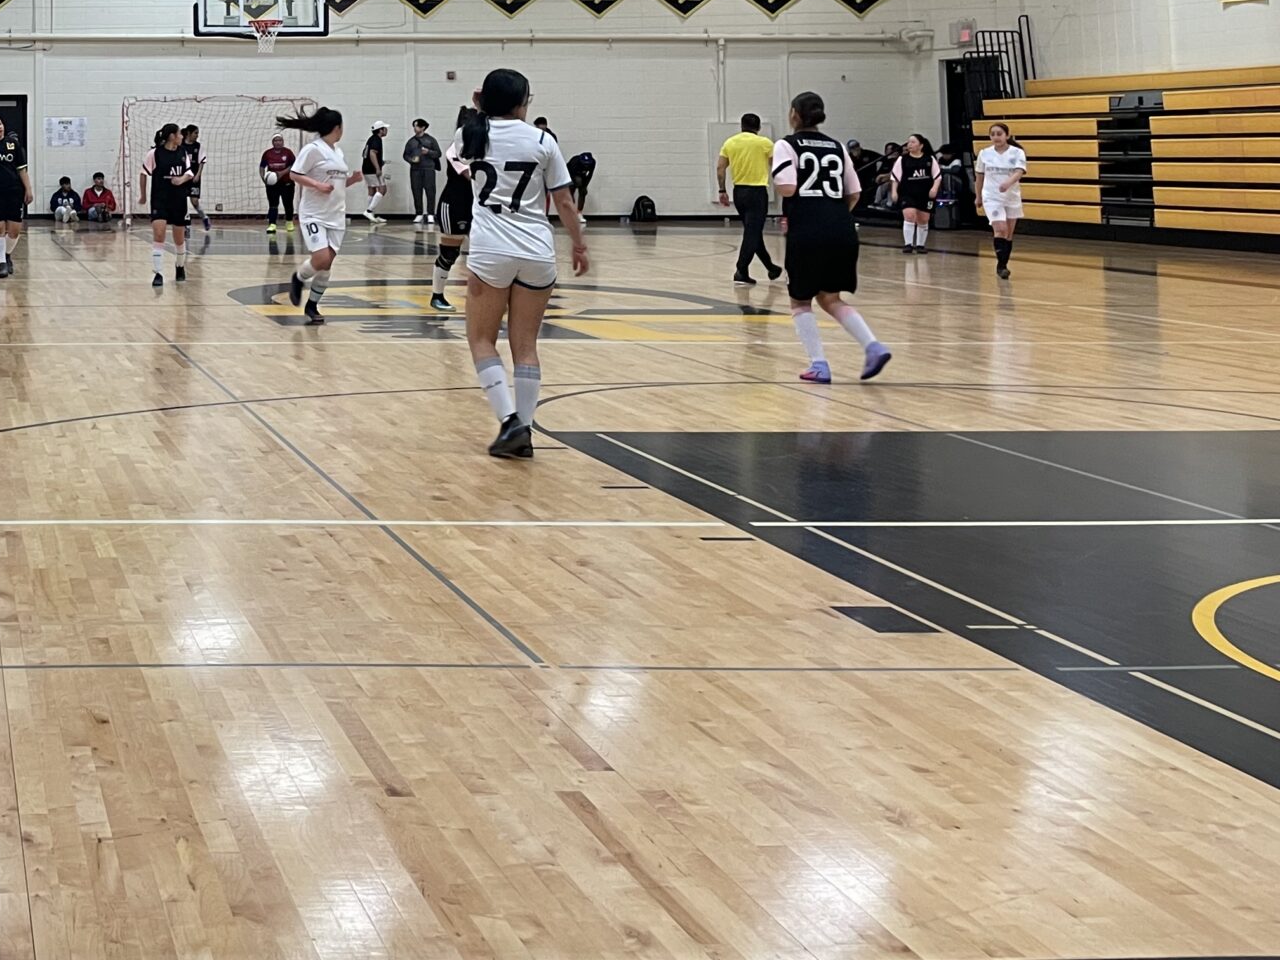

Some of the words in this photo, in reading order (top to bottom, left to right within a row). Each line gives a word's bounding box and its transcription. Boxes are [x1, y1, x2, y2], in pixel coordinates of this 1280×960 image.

[470, 160, 539, 214] 27
[799, 151, 844, 199] 23
[306, 222, 319, 236] 10
